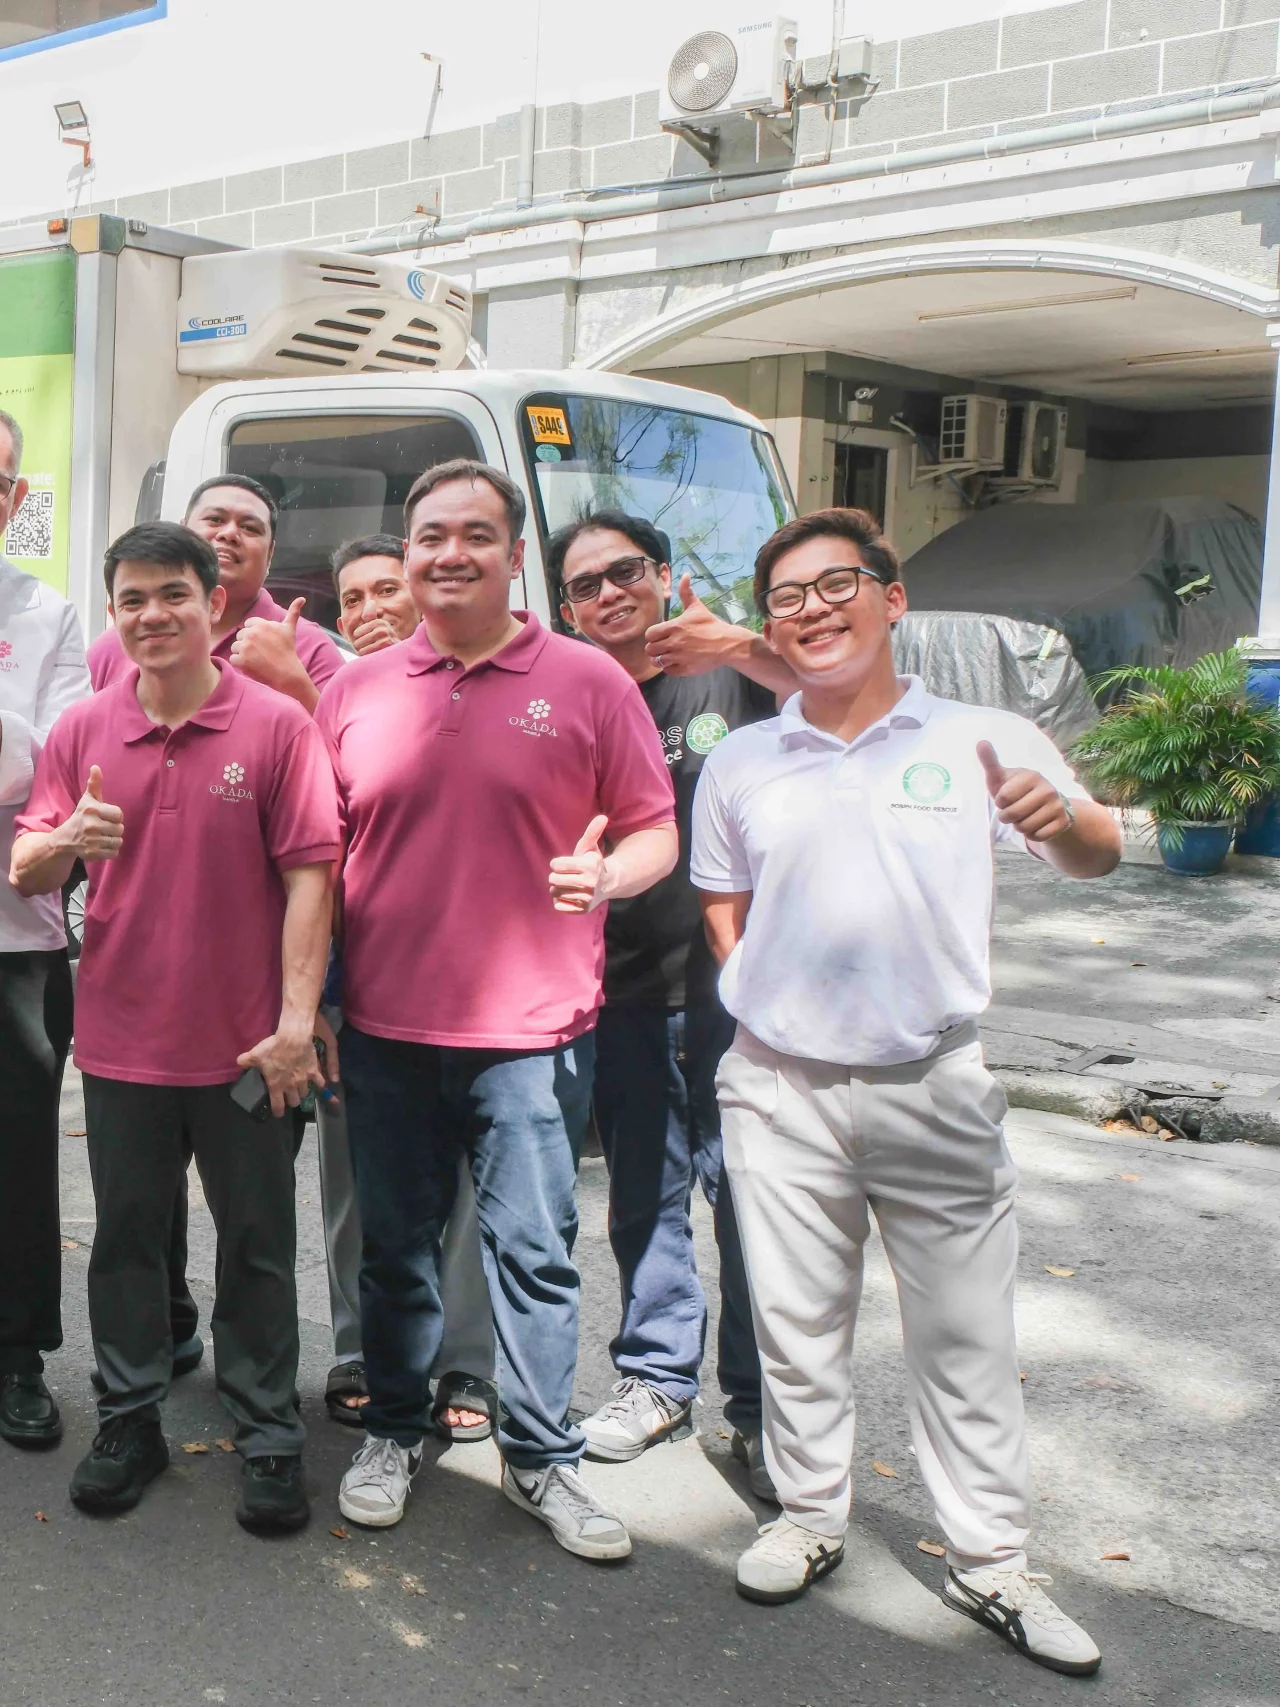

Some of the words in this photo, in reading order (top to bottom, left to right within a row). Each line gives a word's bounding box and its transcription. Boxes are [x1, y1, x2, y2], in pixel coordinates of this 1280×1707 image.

[738, 21, 772, 34] SAMSUNG
[201, 315, 244, 326] COOLAIRE
[216, 325, 245, 337] CCI-300
[508, 716, 558, 737] OKADA
[209, 784, 254, 800] OKADA
[913, 804, 932, 813] FOOD
[933, 805, 958, 814] RESCUE
